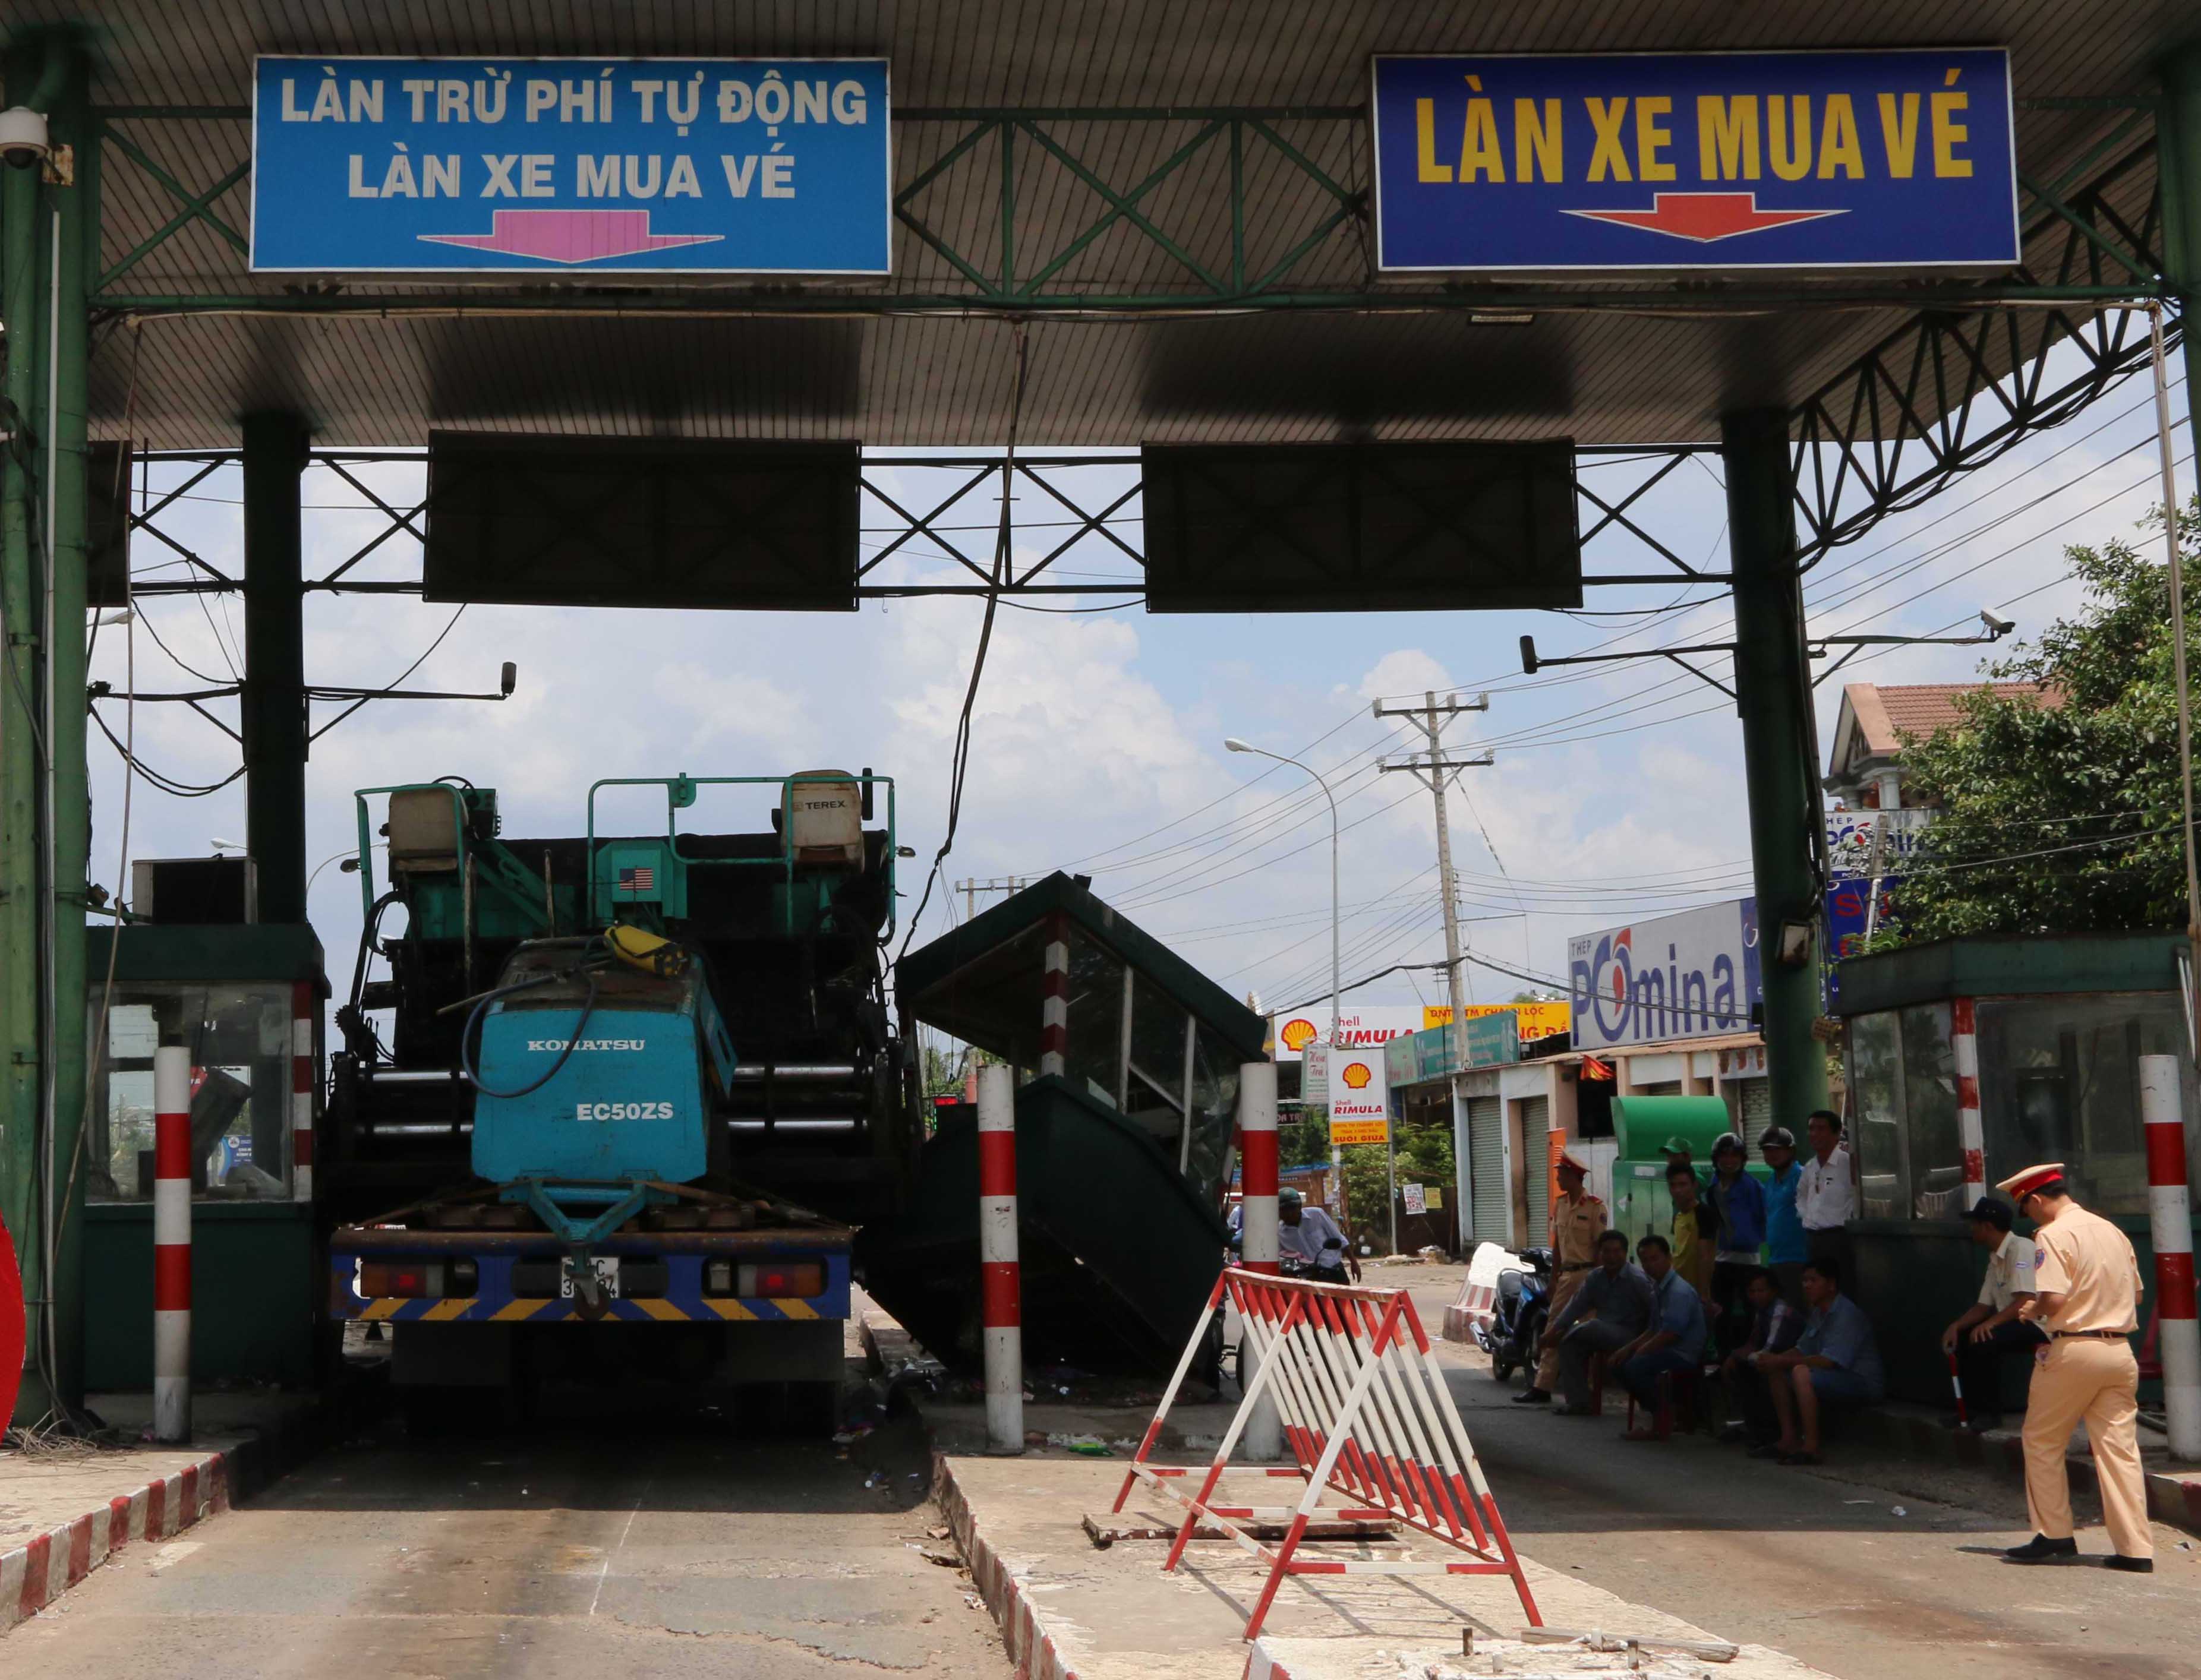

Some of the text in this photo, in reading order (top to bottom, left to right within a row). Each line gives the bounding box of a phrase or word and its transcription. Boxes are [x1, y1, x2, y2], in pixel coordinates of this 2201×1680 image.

[282, 67, 867, 137] LÀN TRỪ PHÍ TỰ ĐỘNG
[1416, 68, 1973, 184] LÀN XE MUA VÉ
[348, 142, 796, 198] LÀN XE MUA VÉ
[805, 800, 846, 810] TEREX
[1331, 1016, 1360, 1027] hell
[528, 1040, 645, 1051] KOMATSU
[576, 1102, 674, 1121] EC50ZS
[1334, 1106, 1383, 1114] RIMULA
